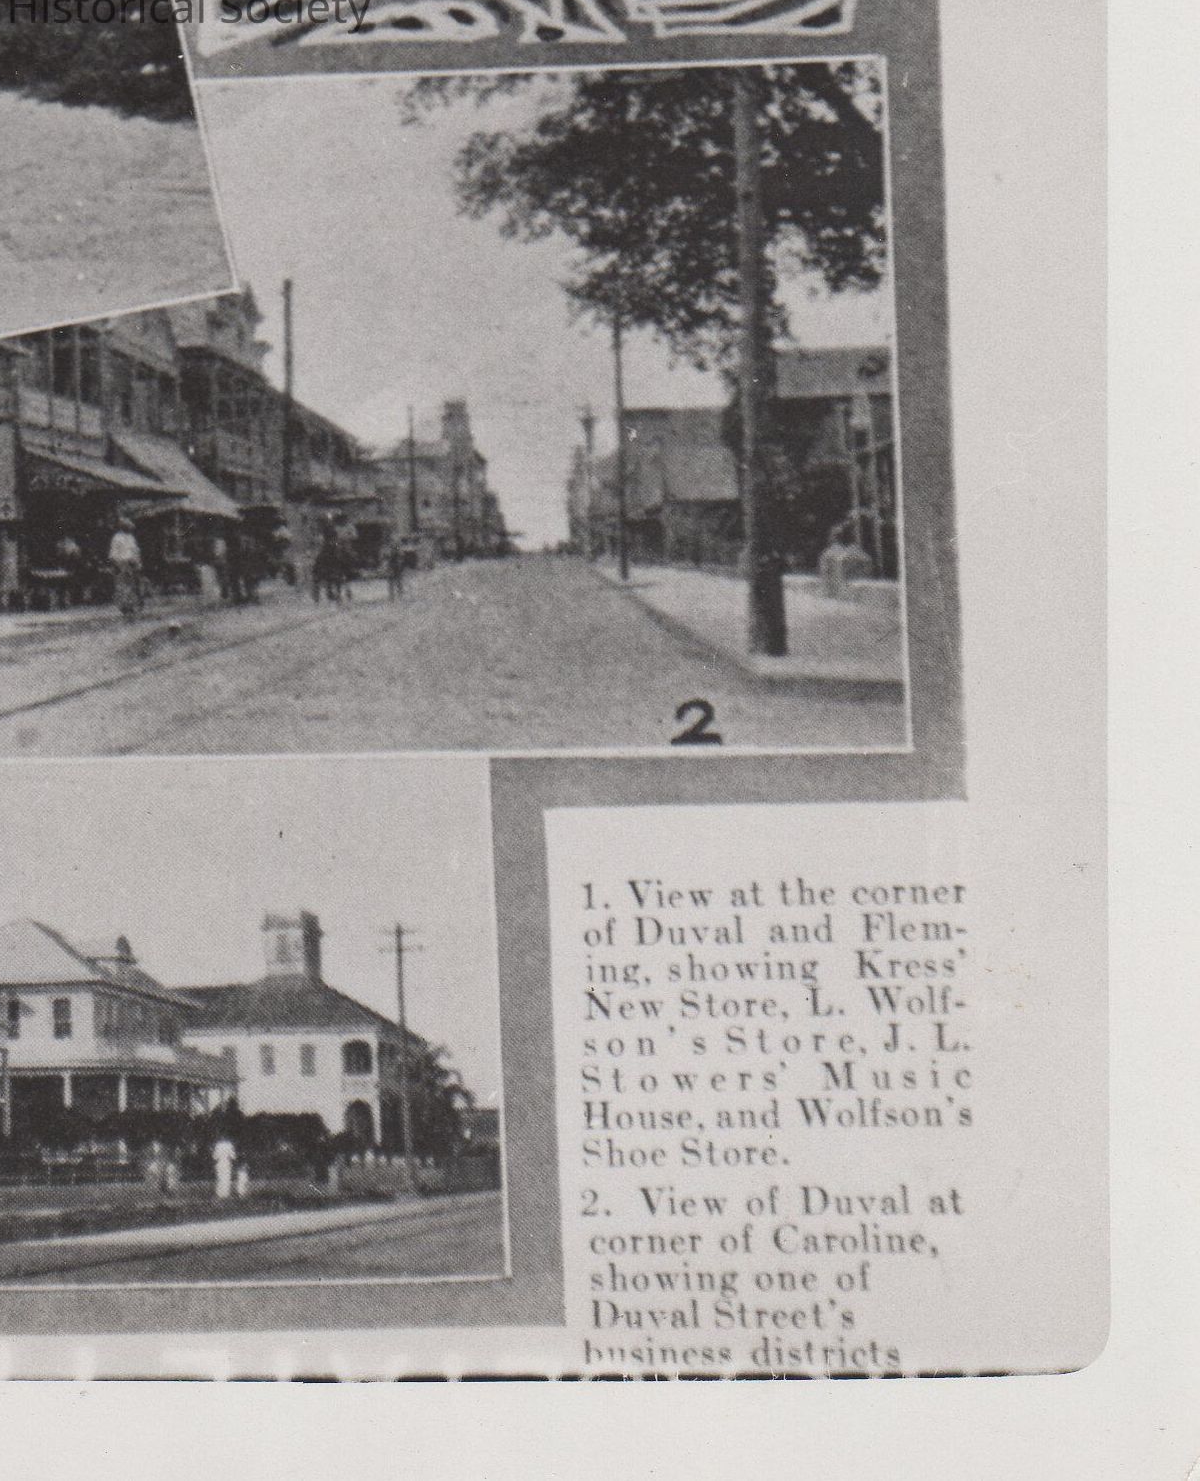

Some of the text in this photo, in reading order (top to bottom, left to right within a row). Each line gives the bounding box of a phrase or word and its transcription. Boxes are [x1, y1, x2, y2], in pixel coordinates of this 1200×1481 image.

[671, 698, 723, 746] 2
[582, 877, 965, 910] 1. View at the corner
[583, 911, 966, 947] of Duval and Flem-
[587, 948, 966, 986] ing, showing Kress'
[584, 985, 965, 1020] New Store, L. Wolf-
[584, 1021, 970, 1056] son's Store, J. L.
[581, 1060, 971, 1093] Stowers' Music
[583, 1096, 972, 1131] House, and Wolfson's
[583, 1138, 789, 1167] Shoe Store.
[581, 1184, 962, 1217] 2. View of Duval at
[589, 1223, 938, 1258] corner of Caroline,
[591, 1261, 870, 1295] showing one of
[592, 1297, 854, 1329] Duval Street's
[750, 1335, 900, 1366] districts
